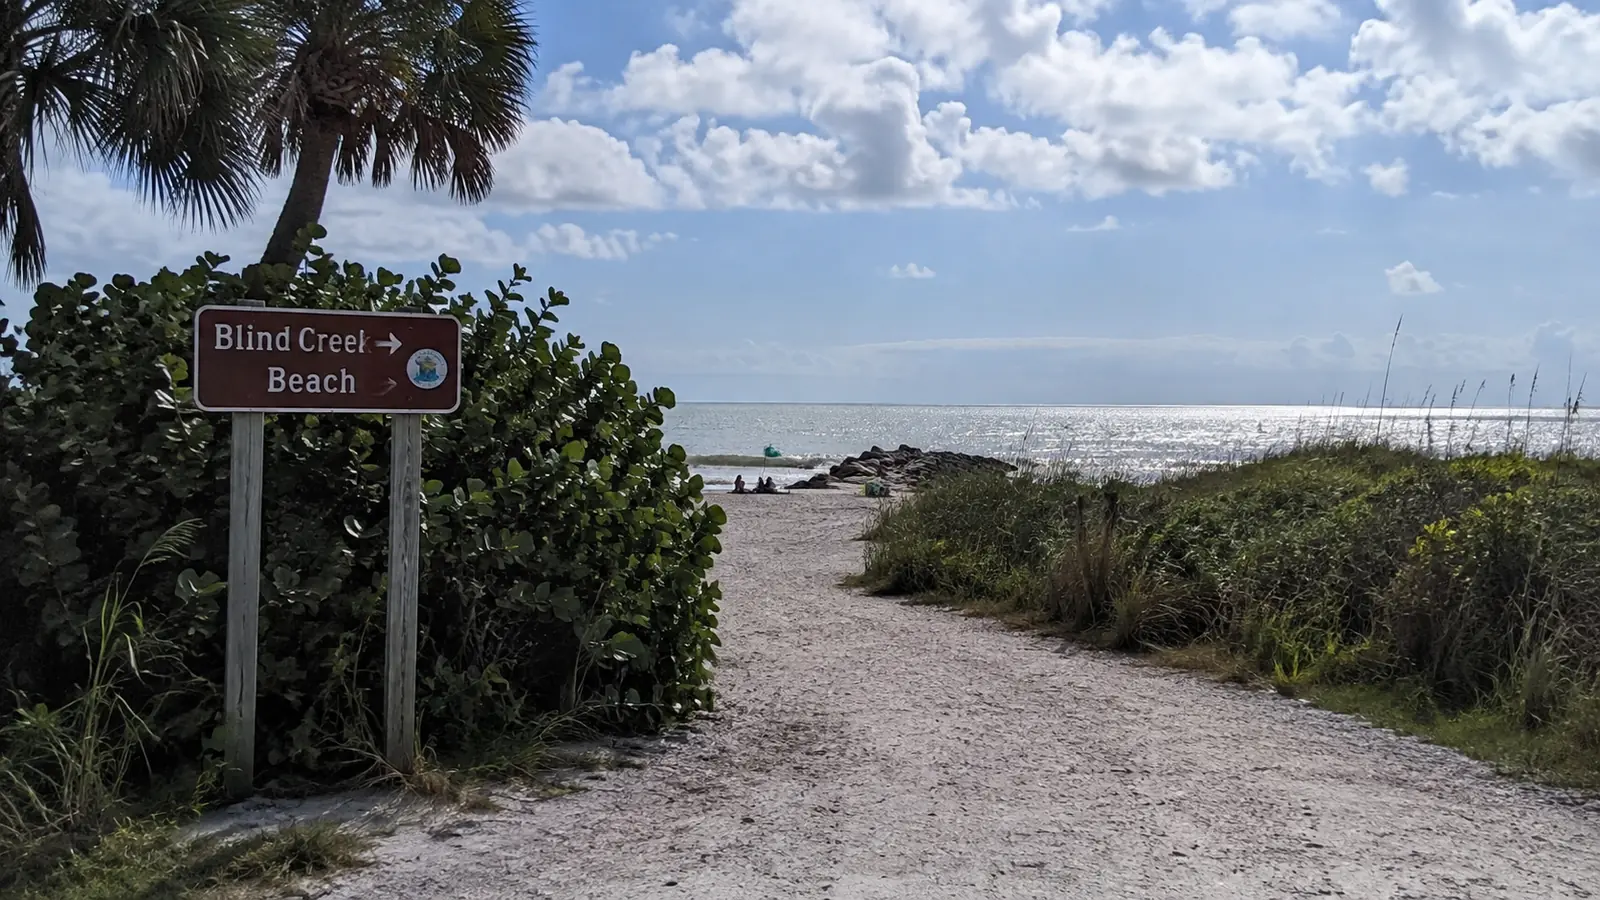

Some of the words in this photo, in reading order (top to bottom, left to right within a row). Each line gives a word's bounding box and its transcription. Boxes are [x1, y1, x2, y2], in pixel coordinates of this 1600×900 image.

[214, 323, 291, 351] Blind
[299, 327, 371, 354] Creek
[267, 366, 356, 393] Beach
